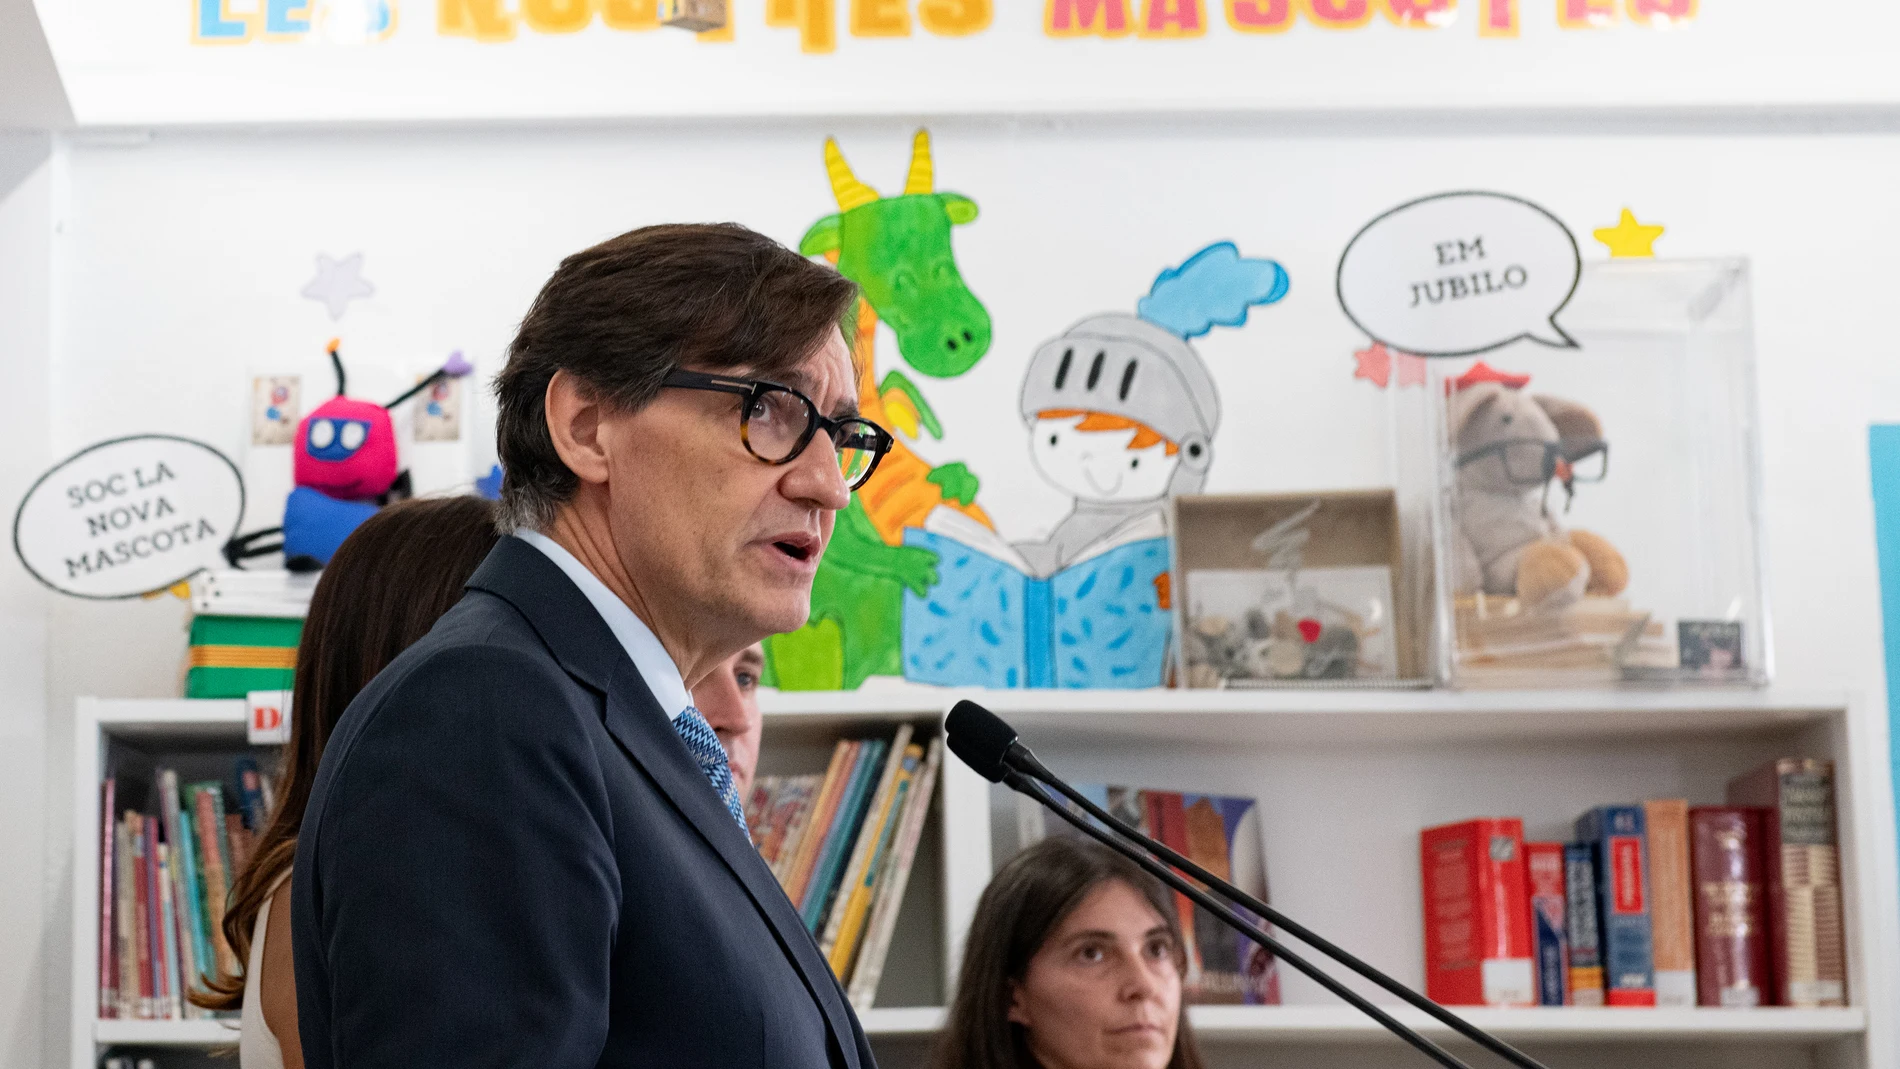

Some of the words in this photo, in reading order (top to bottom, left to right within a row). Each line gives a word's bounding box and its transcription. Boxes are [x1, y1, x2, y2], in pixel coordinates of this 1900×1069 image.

[1434, 236, 1486, 266] EM
[1410, 264, 1528, 308] JUBILO
[66, 473, 127, 509] SOC
[134, 461, 175, 488] LA
[86, 496, 175, 537] NOVA
[64, 517, 217, 578] MASCOTA
[254, 706, 283, 730] D
